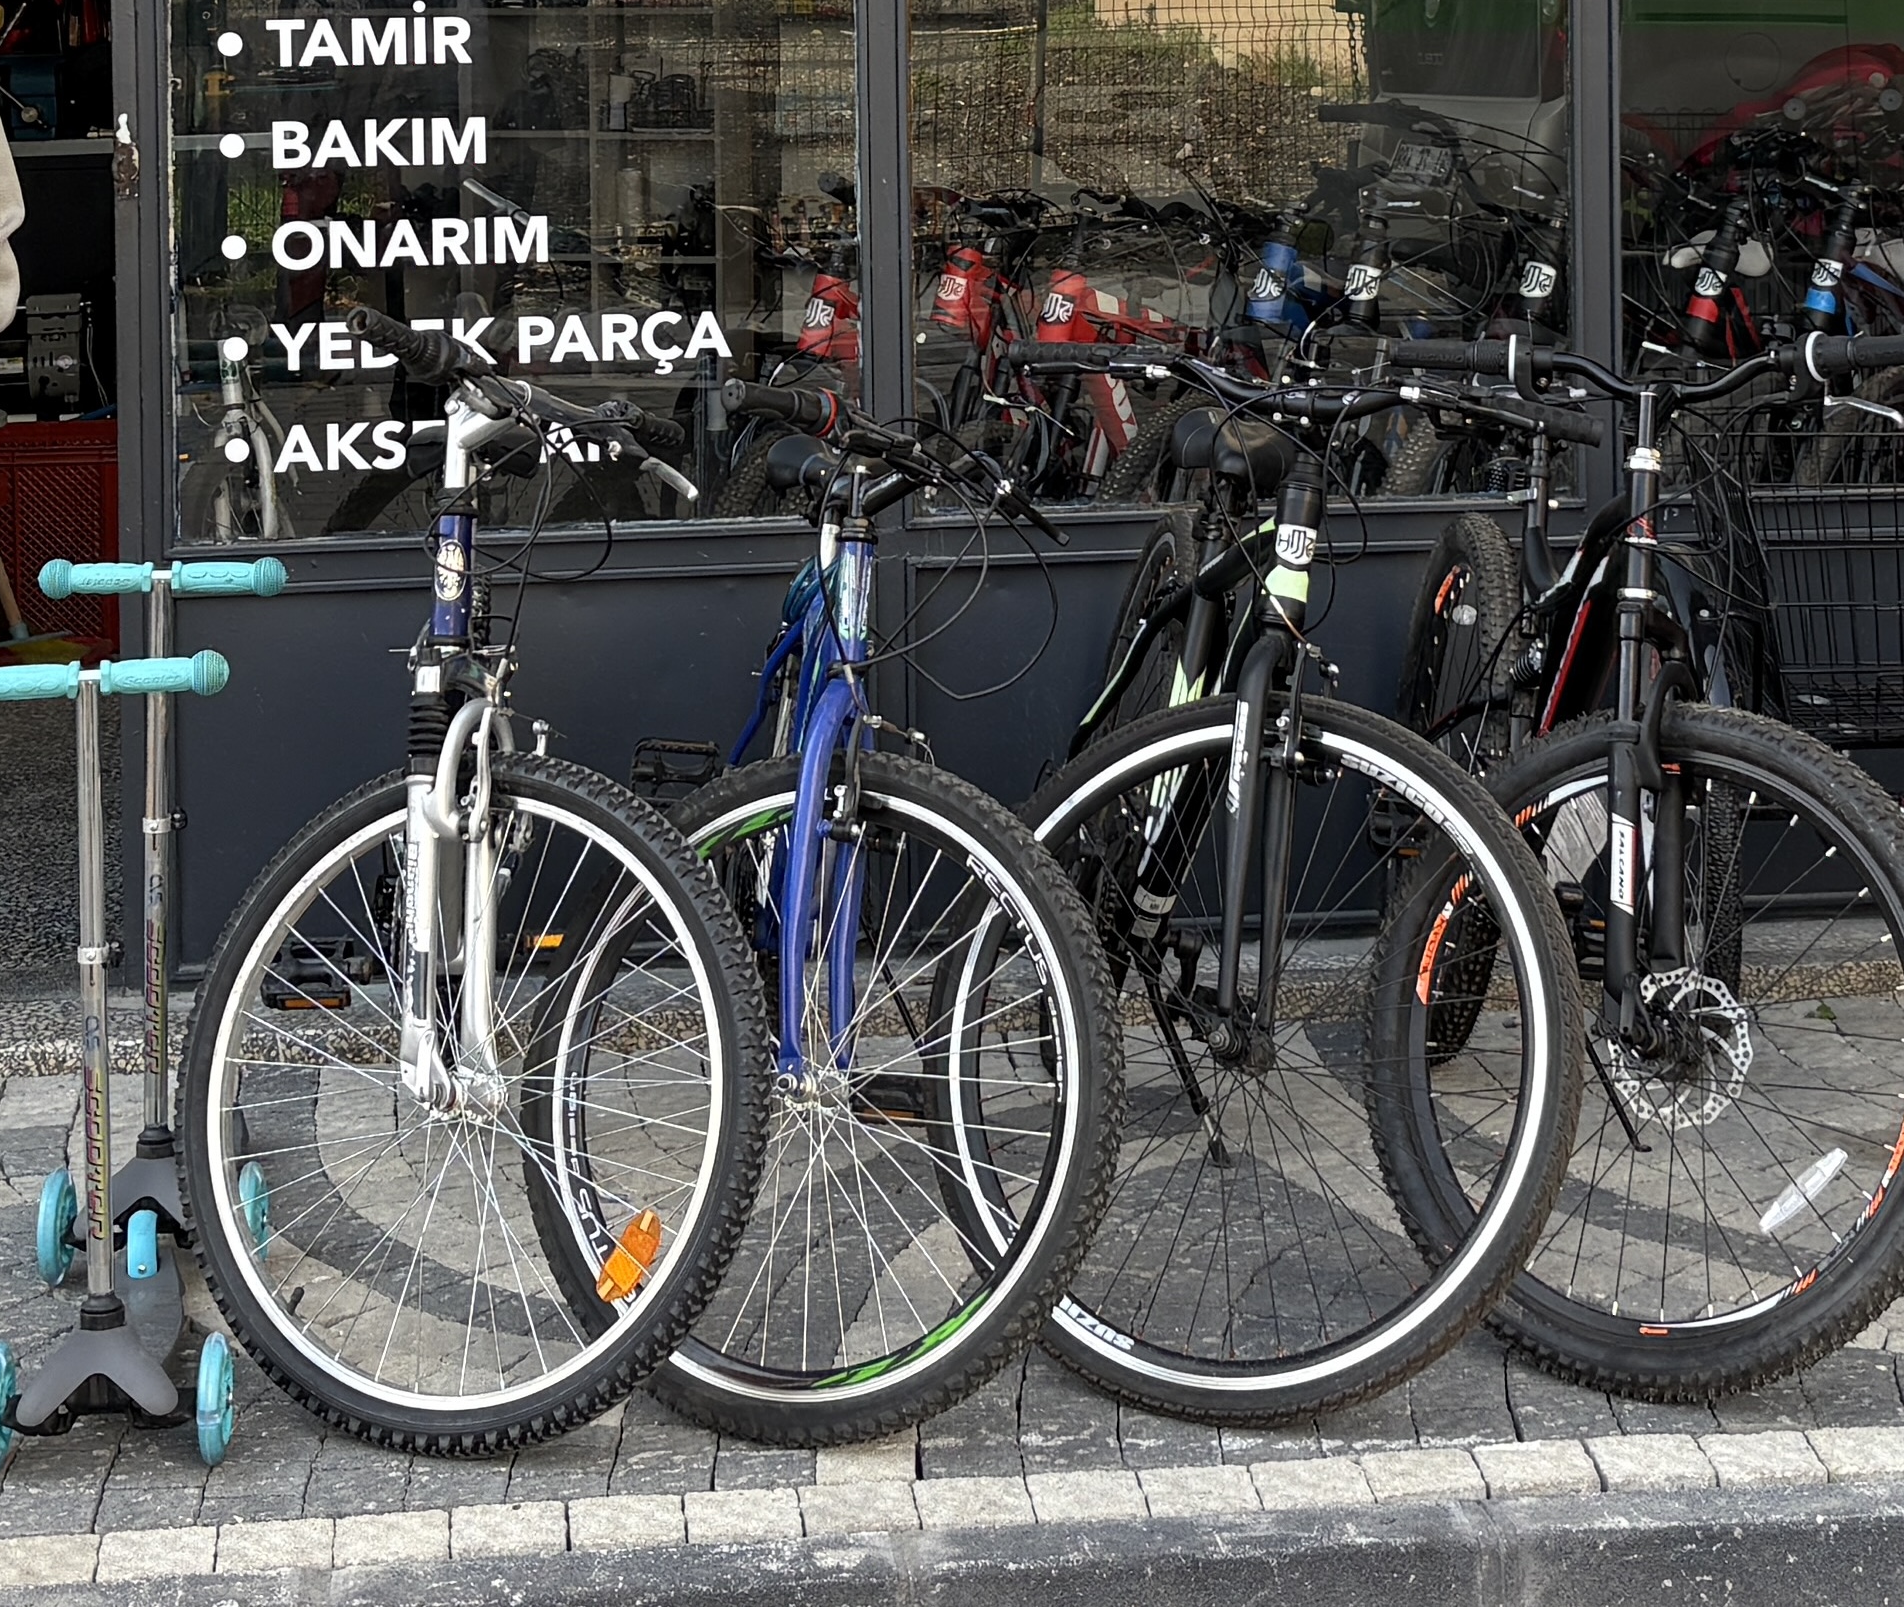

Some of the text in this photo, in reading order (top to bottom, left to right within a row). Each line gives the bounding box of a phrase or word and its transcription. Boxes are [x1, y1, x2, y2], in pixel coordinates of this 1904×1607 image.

[266, 0, 472, 67] TAMİR
[272, 117, 487, 169] BAKIM
[272, 216, 549, 270] ONARIM
[518, 311, 732, 374] PARÇA
[966, 854, 1047, 985] RECTUS
[84, 1065, 106, 1241] SCOOTER
